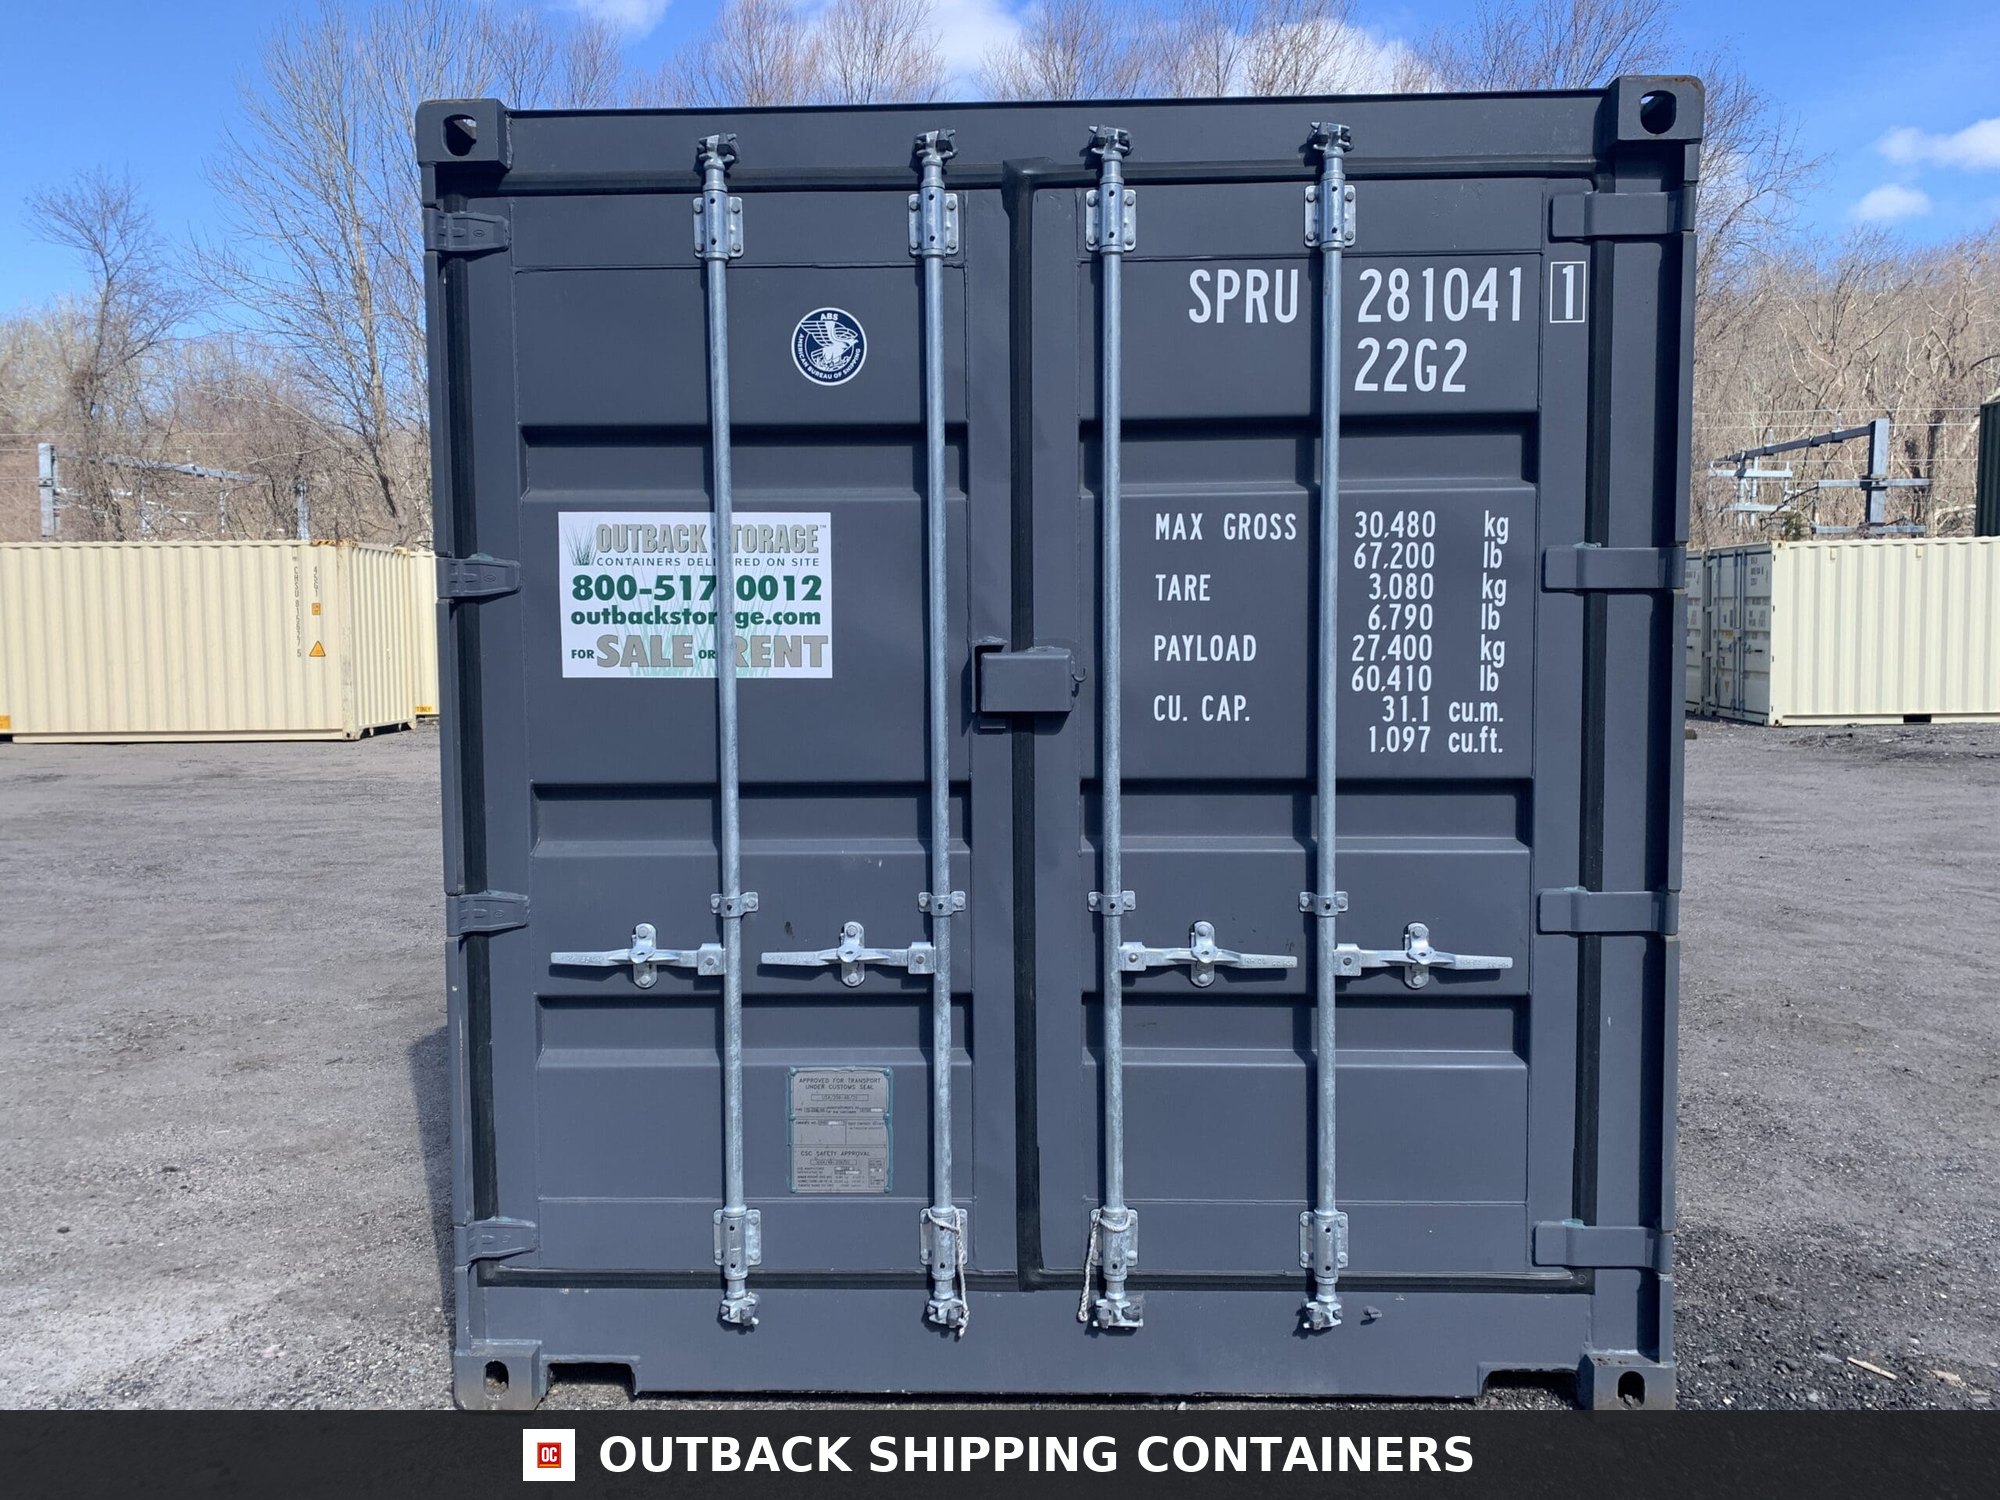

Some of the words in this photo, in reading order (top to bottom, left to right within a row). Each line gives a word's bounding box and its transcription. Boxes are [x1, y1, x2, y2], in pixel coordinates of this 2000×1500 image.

[1189, 269, 1298, 323] SPRU
[1358, 267, 1521, 322] 281041
[1562, 265, 1574, 320] 1
[820, 312, 839, 321] ABS
[797, 333, 809, 368] AMERICAN
[807, 367, 833, 379] BUREAU
[833, 371, 843, 379] OF
[842, 348, 861, 375] SHIPPING
[1355, 338, 1467, 392] 22G2
[596, 524, 708, 553] OUTBACK
[1156, 513, 1202, 540] MAX
[1224, 513, 1296, 540] GROSS
[1355, 511, 1435, 538] 30,480
[1485, 510, 1509, 542] kg
[597, 558, 680, 566] CONTAINERS
[688, 557, 760, 567] DELIRED
[768, 558, 784, 566] ON
[792, 558, 818, 566] SITE
[1354, 542, 1434, 569] 67,200
[1484, 542, 1503, 569] lb
[572, 574, 821, 602] 800-5170012
[1156, 575, 1210, 601] TARE
[1369, 573, 1433, 599] 3,080
[1482, 573, 1507, 606] kg
[571, 605, 820, 629] outbackstorge.com
[1369, 604, 1432, 630] 6,790
[1482, 604, 1501, 630] lb
[572, 650, 594, 658] FOR
[597, 635, 693, 668] SALE
[699, 649, 717, 659] OR
[1155, 635, 1256, 661] PAYLOAD
[1352, 635, 1432, 661] 27,400
[1481, 635, 1506, 668] kg
[1352, 665, 1431, 691] 60,410
[1480, 666, 1500, 691] lb
[1154, 695, 1187, 721] CU.
[1202, 695, 1249, 721] CAP.
[1383, 696, 1428, 722] 31.1
[1449, 702, 1503, 722] cu.m.
[1370, 726, 1430, 752] 1,097
[1449, 726, 1502, 753] cu.ft.
